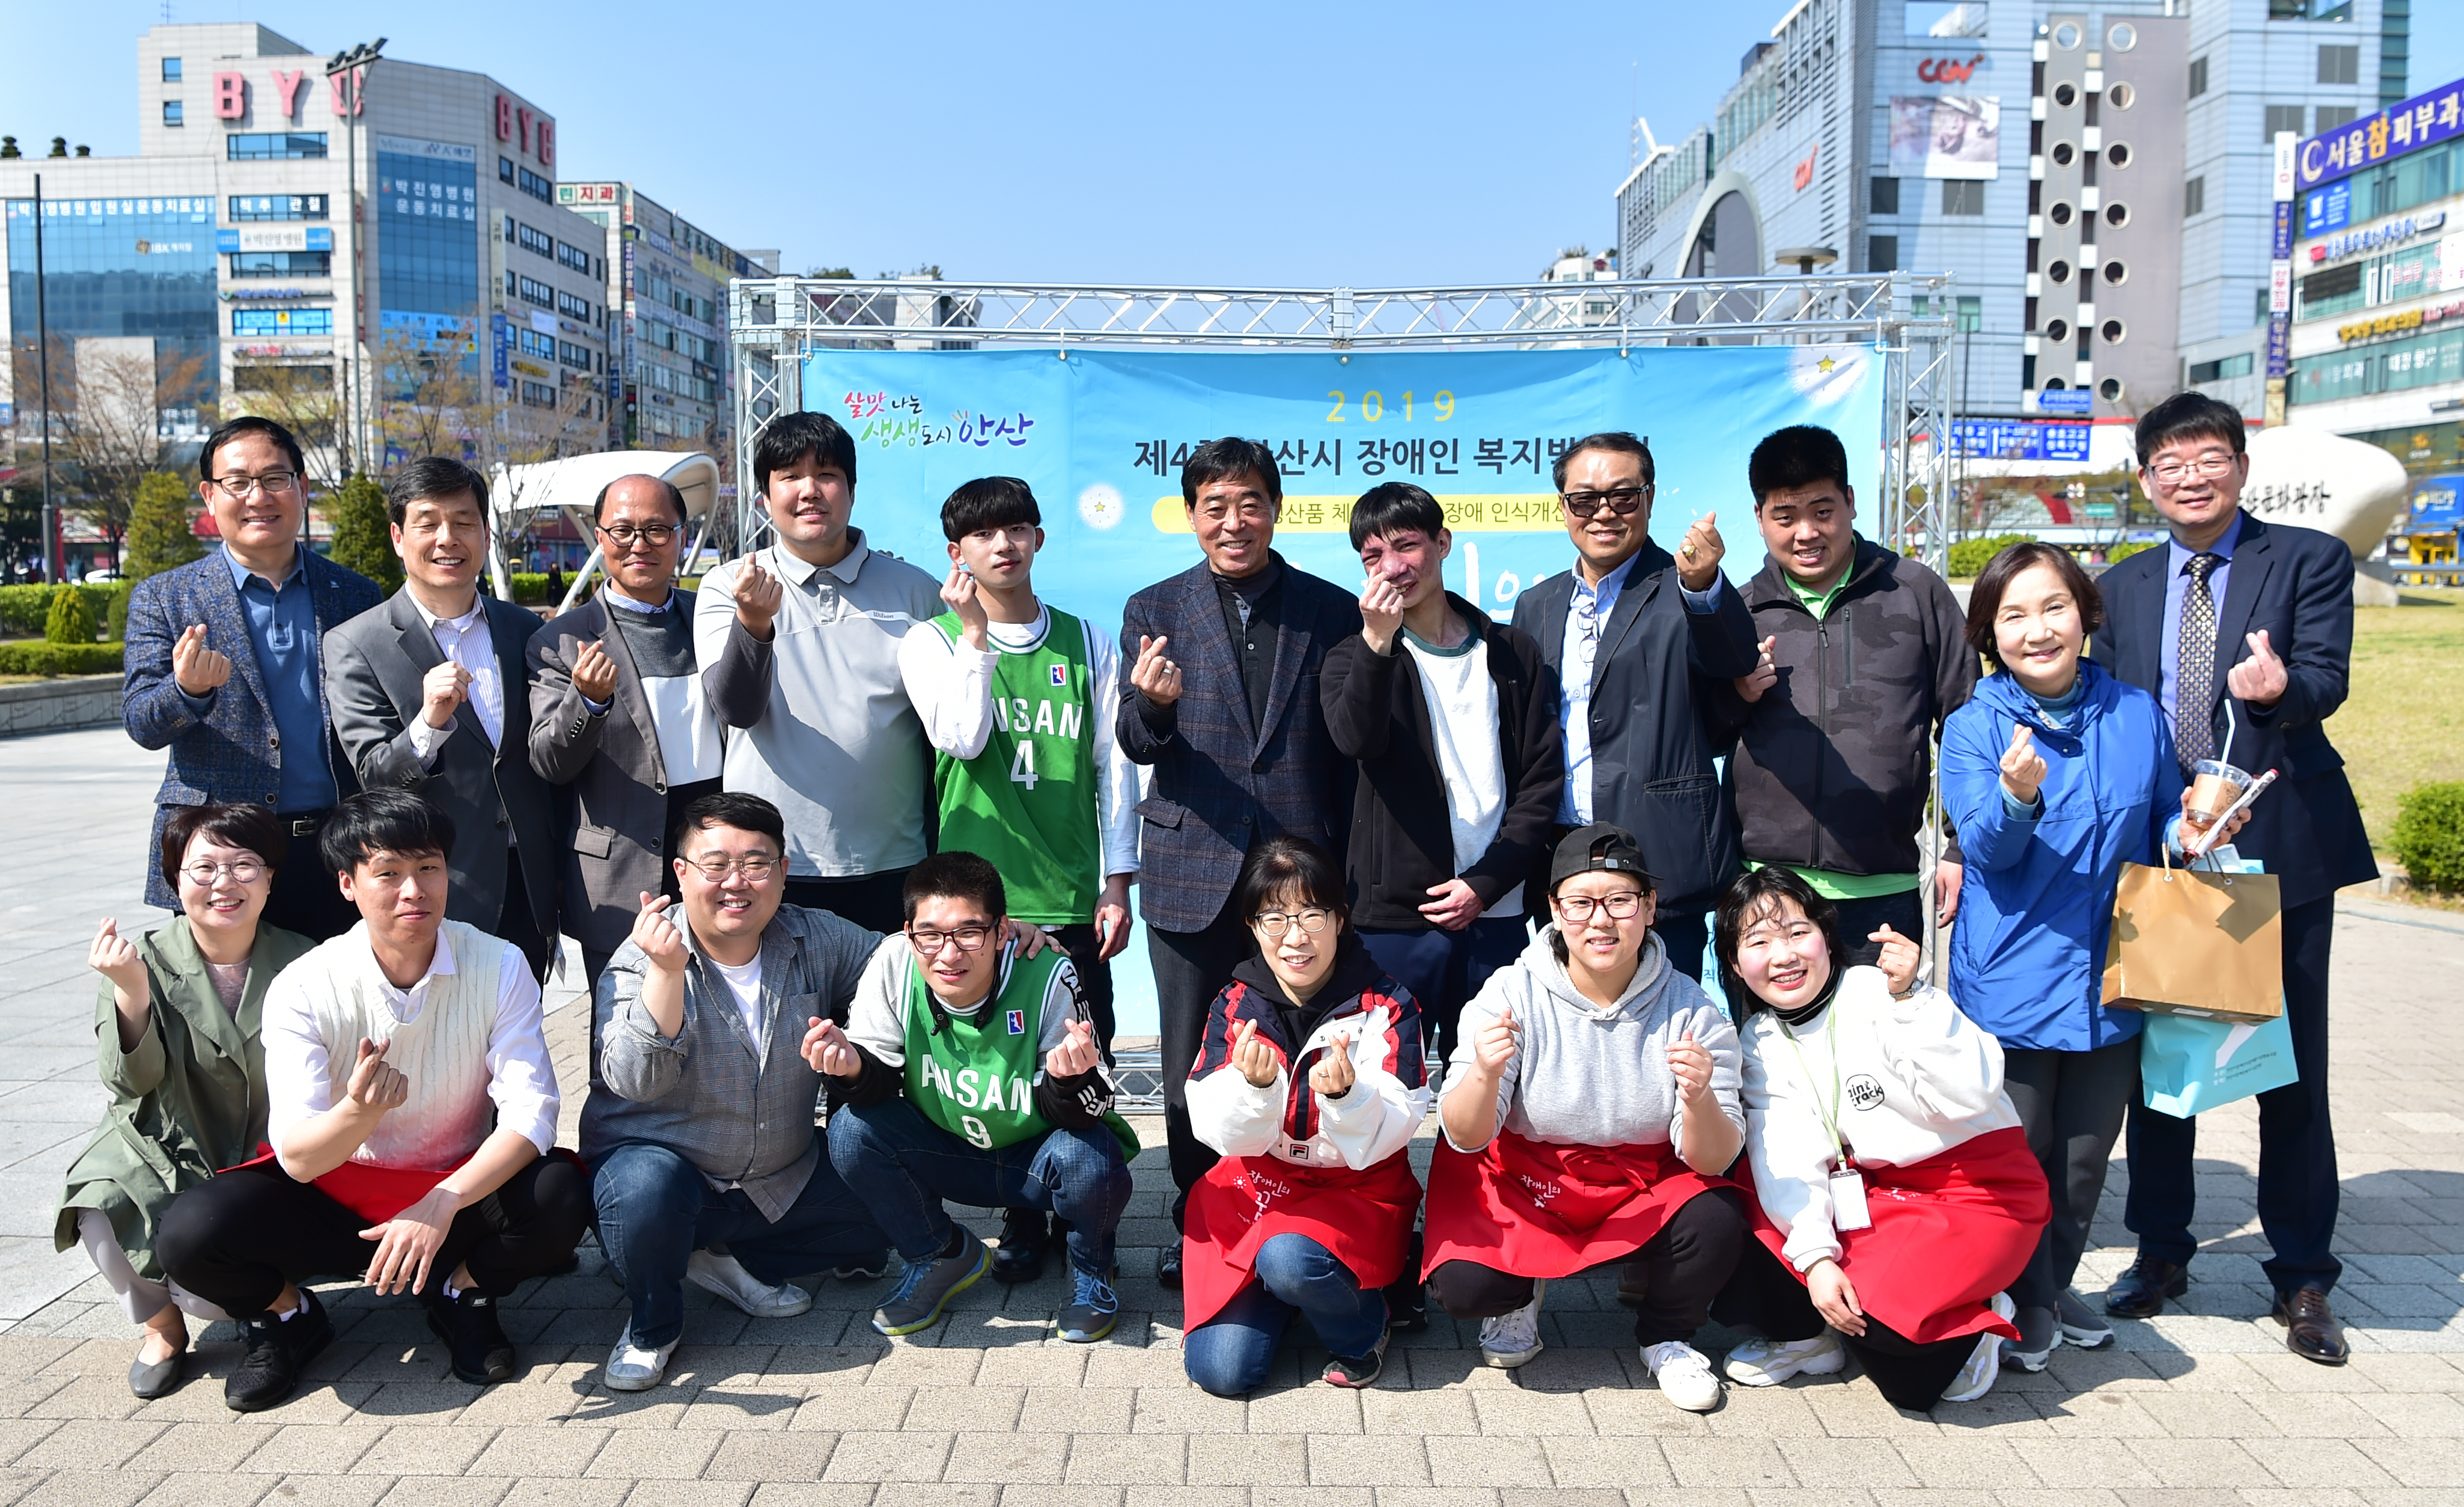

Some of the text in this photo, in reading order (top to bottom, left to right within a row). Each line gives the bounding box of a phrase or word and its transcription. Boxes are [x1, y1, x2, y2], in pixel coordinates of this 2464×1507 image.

[496, 93, 554, 167] BYC
[844, 391, 923, 419] 살맛 나는
[958, 411, 1034, 447] 안산
[1133, 439, 1212, 477] 제4
[1263, 439, 1341, 476] 산시
[1356, 438, 1459, 476] 장애인
[1332, 503, 1350, 524] 체
[1444, 502, 1483, 524] 장애
[2237, 479, 2332, 513] 산문화광장
[990, 697, 1083, 740] NSAN
[1010, 739, 1039, 791] 4
[921, 1053, 1031, 1116] ANSAN
[961, 1114, 993, 1149] 9
[1246, 1169, 1291, 1198] 장애인의
[1520, 1174, 1561, 1199] 장애인의
